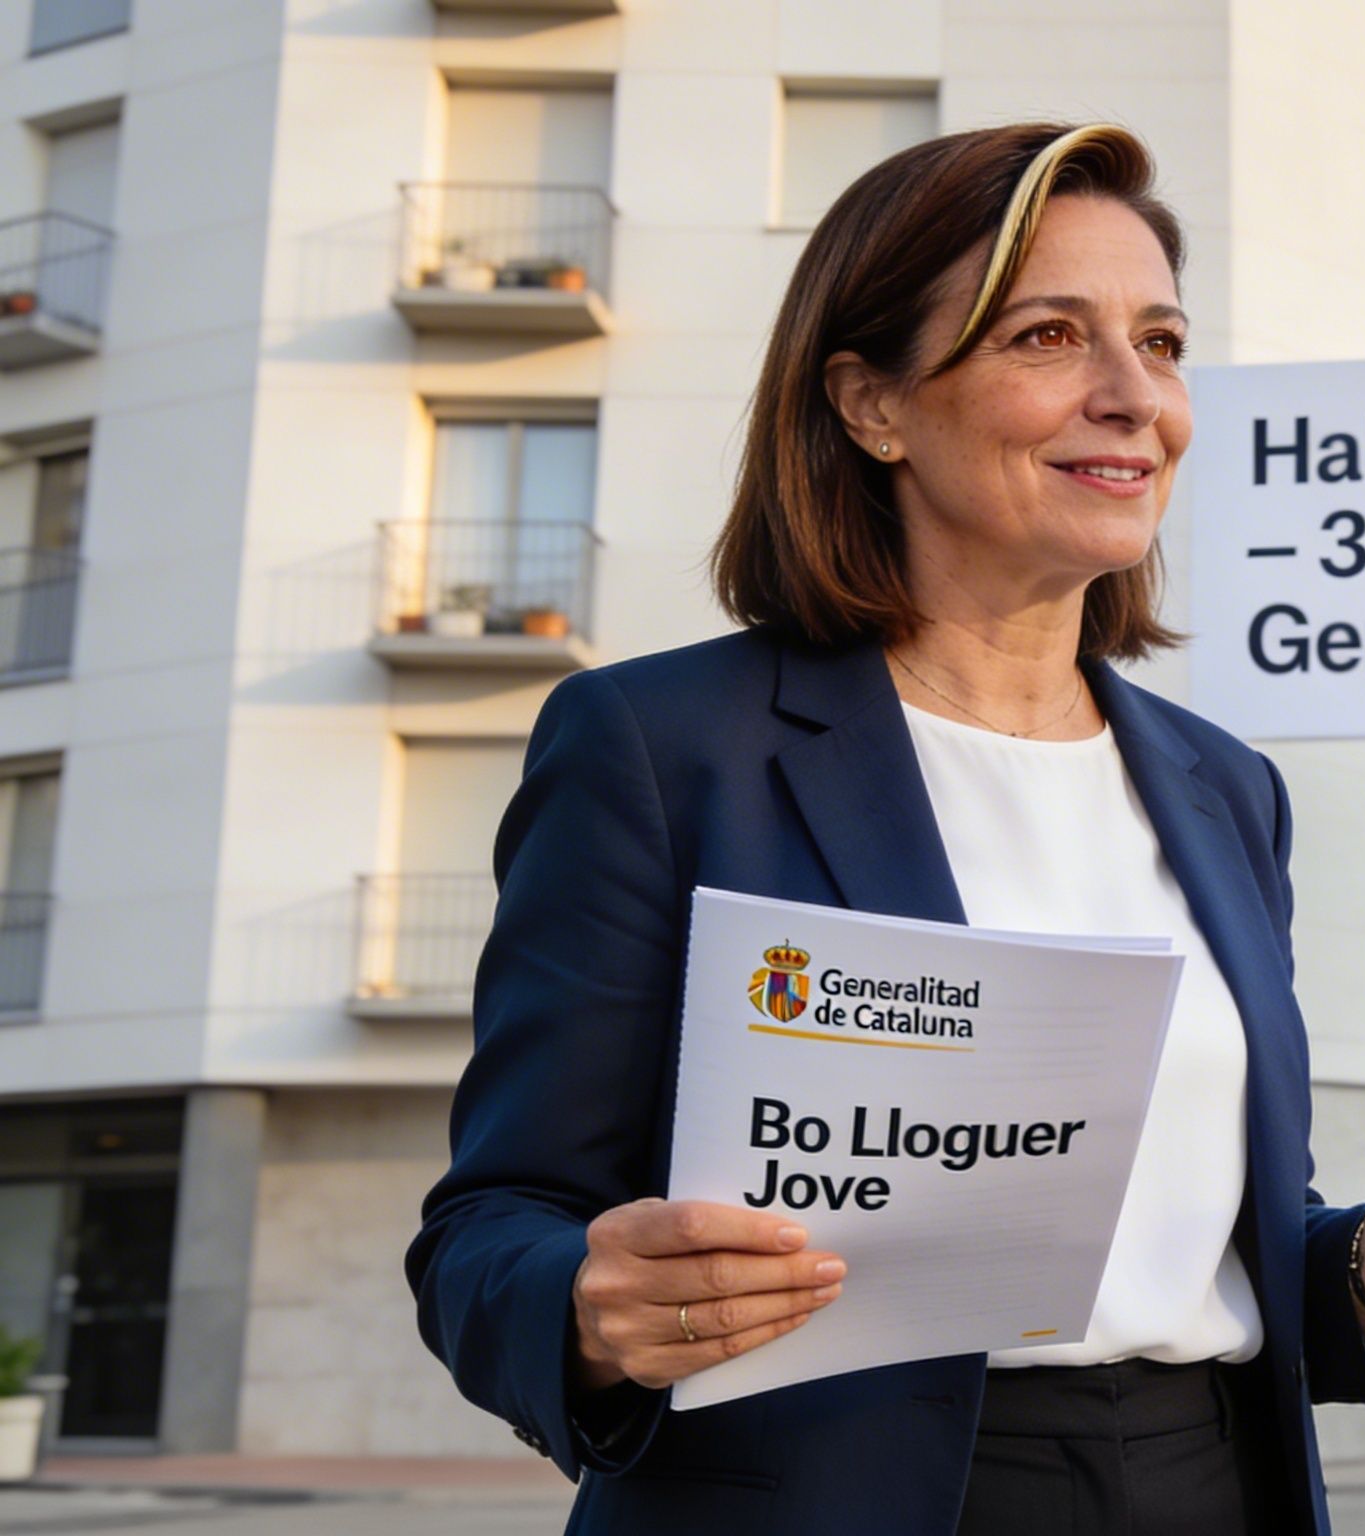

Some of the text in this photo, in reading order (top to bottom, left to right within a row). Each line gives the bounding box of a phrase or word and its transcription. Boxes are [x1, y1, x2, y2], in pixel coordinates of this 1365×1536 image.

[819, 967, 980, 1009] Generalitad
[814, 997, 974, 1039] de Cataluna
[749, 1096, 1086, 1172] Bo Lloguer
[742, 1158, 891, 1211] Jove
